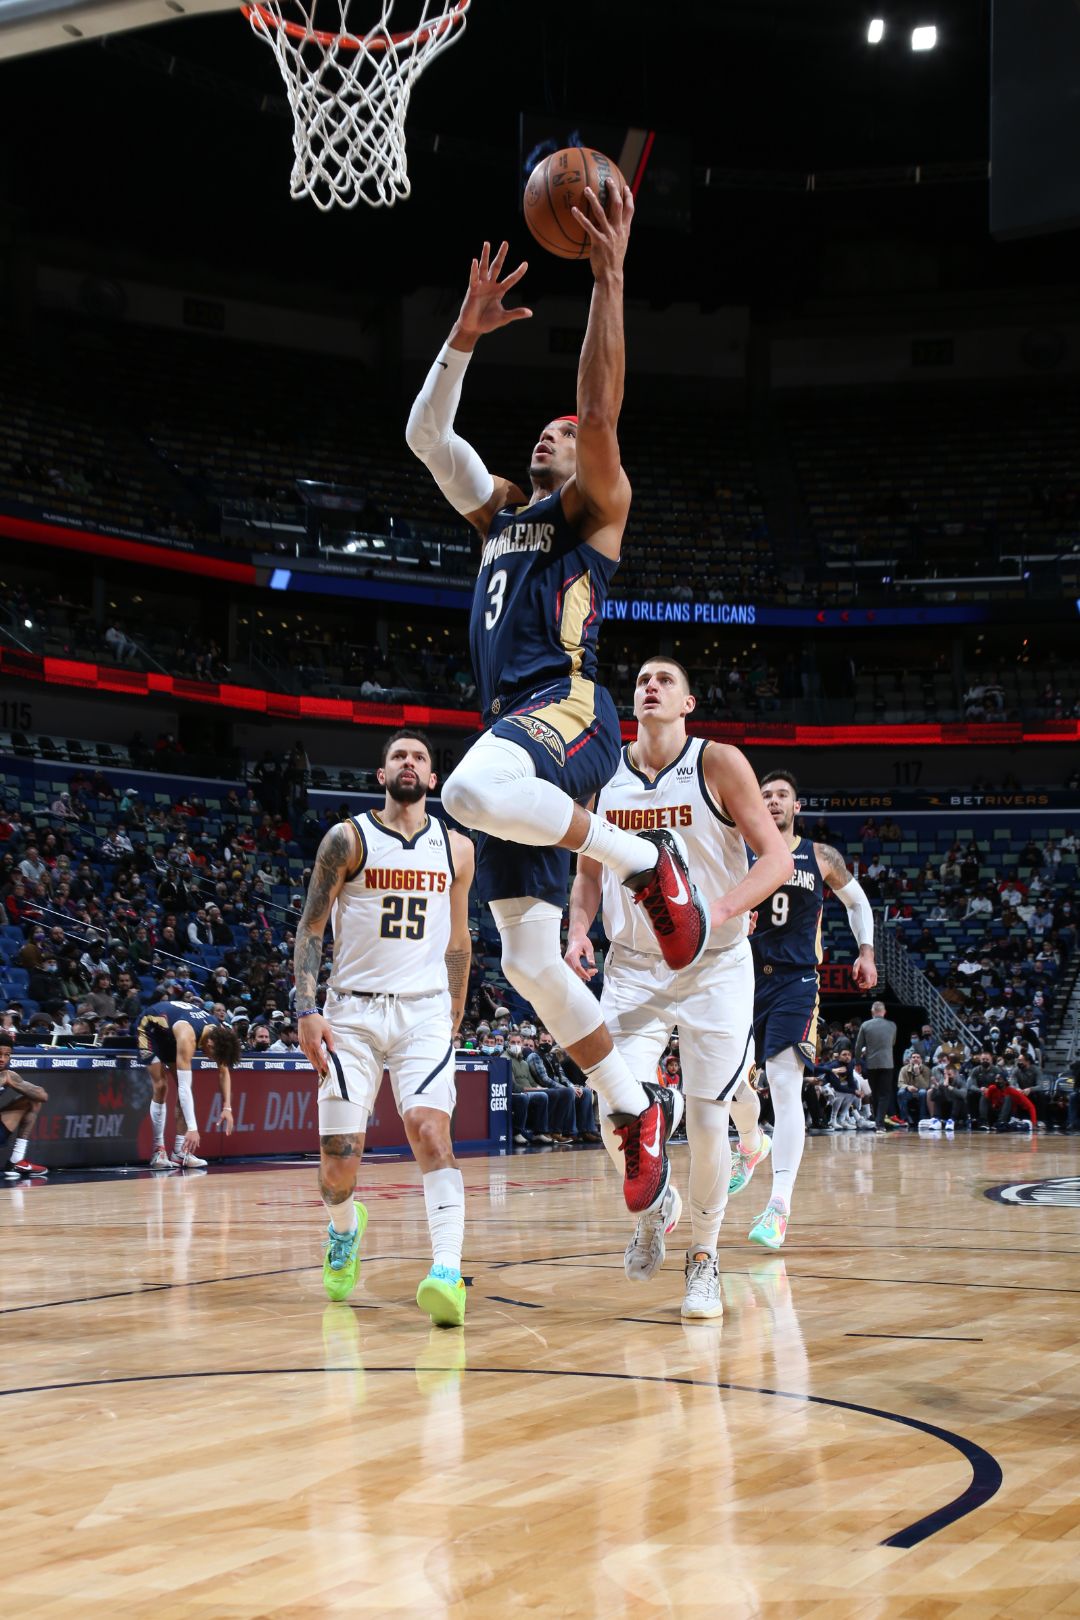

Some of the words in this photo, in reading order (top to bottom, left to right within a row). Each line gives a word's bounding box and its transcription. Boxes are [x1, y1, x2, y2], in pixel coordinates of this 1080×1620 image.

[485, 569, 508, 631] 3
[632, 601, 690, 622] ORLEANS
[695, 603, 756, 624] PELICANS
[1, 701, 32, 730] 115
[676, 766, 693, 776] WU
[892, 761, 922, 785] 117
[950, 795, 1049, 806] BETRIVERS
[605, 804, 691, 830] NUGGETS
[365, 868, 447, 893] NUGGETS
[380, 895, 428, 940] 25
[771, 892, 789, 927] 9
[491, 1083, 507, 1097] SEAT
[263, 1091, 313, 1131] DAY.
[490, 1097, 508, 1111] GEEK
[64, 1114, 94, 1138] THE
